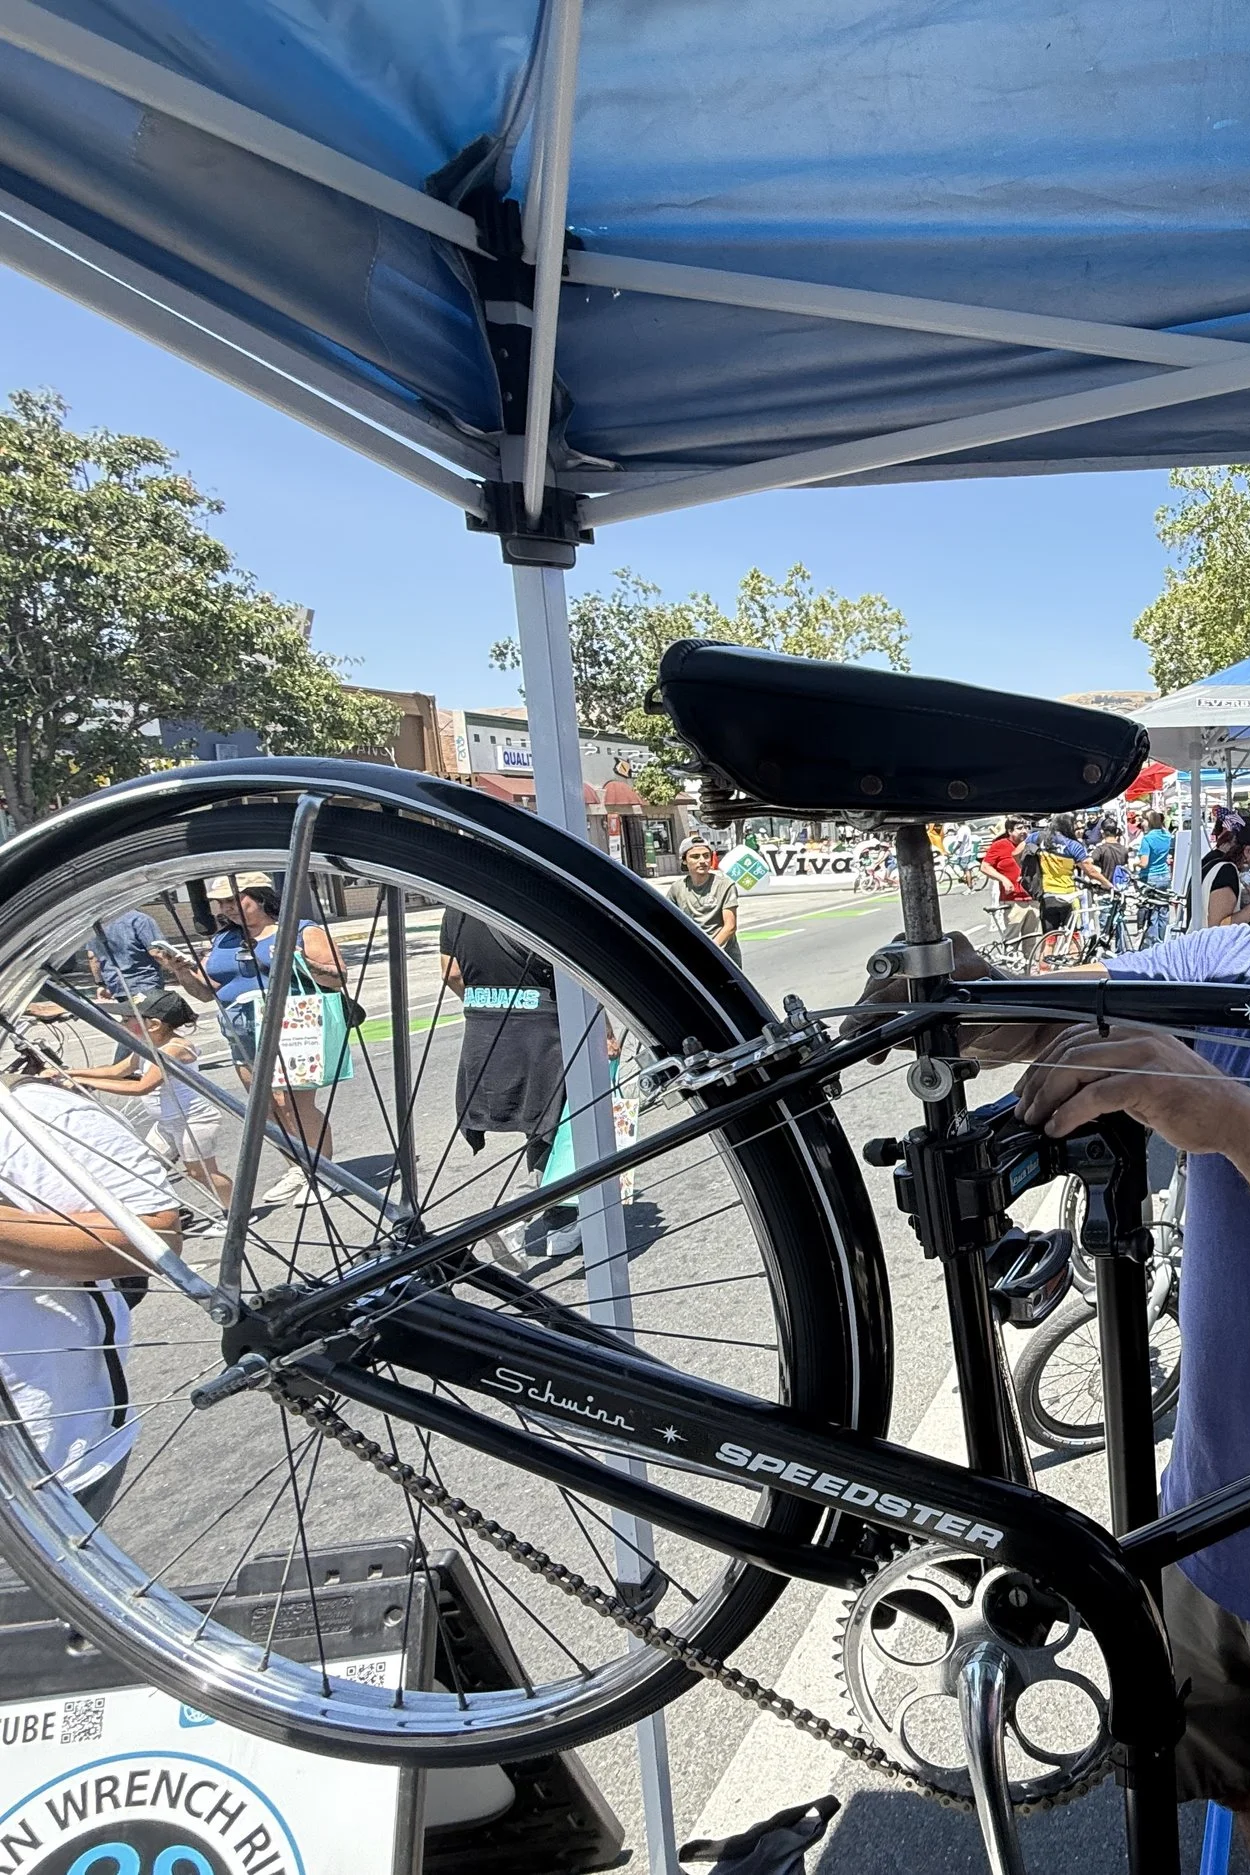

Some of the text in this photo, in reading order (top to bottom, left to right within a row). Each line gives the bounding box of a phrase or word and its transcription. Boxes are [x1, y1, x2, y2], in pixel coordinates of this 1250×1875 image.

[503, 751, 533, 767] QUALI
[766, 850, 852, 876] Viva
[480, 1366, 636, 1432] Schwinn
[714, 1442, 1005, 1550] SPEEDSTER
[0, 1711, 56, 1746] UBE
[45, 1769, 248, 1836] WRENCH
[234, 1823, 287, 1875] RI
